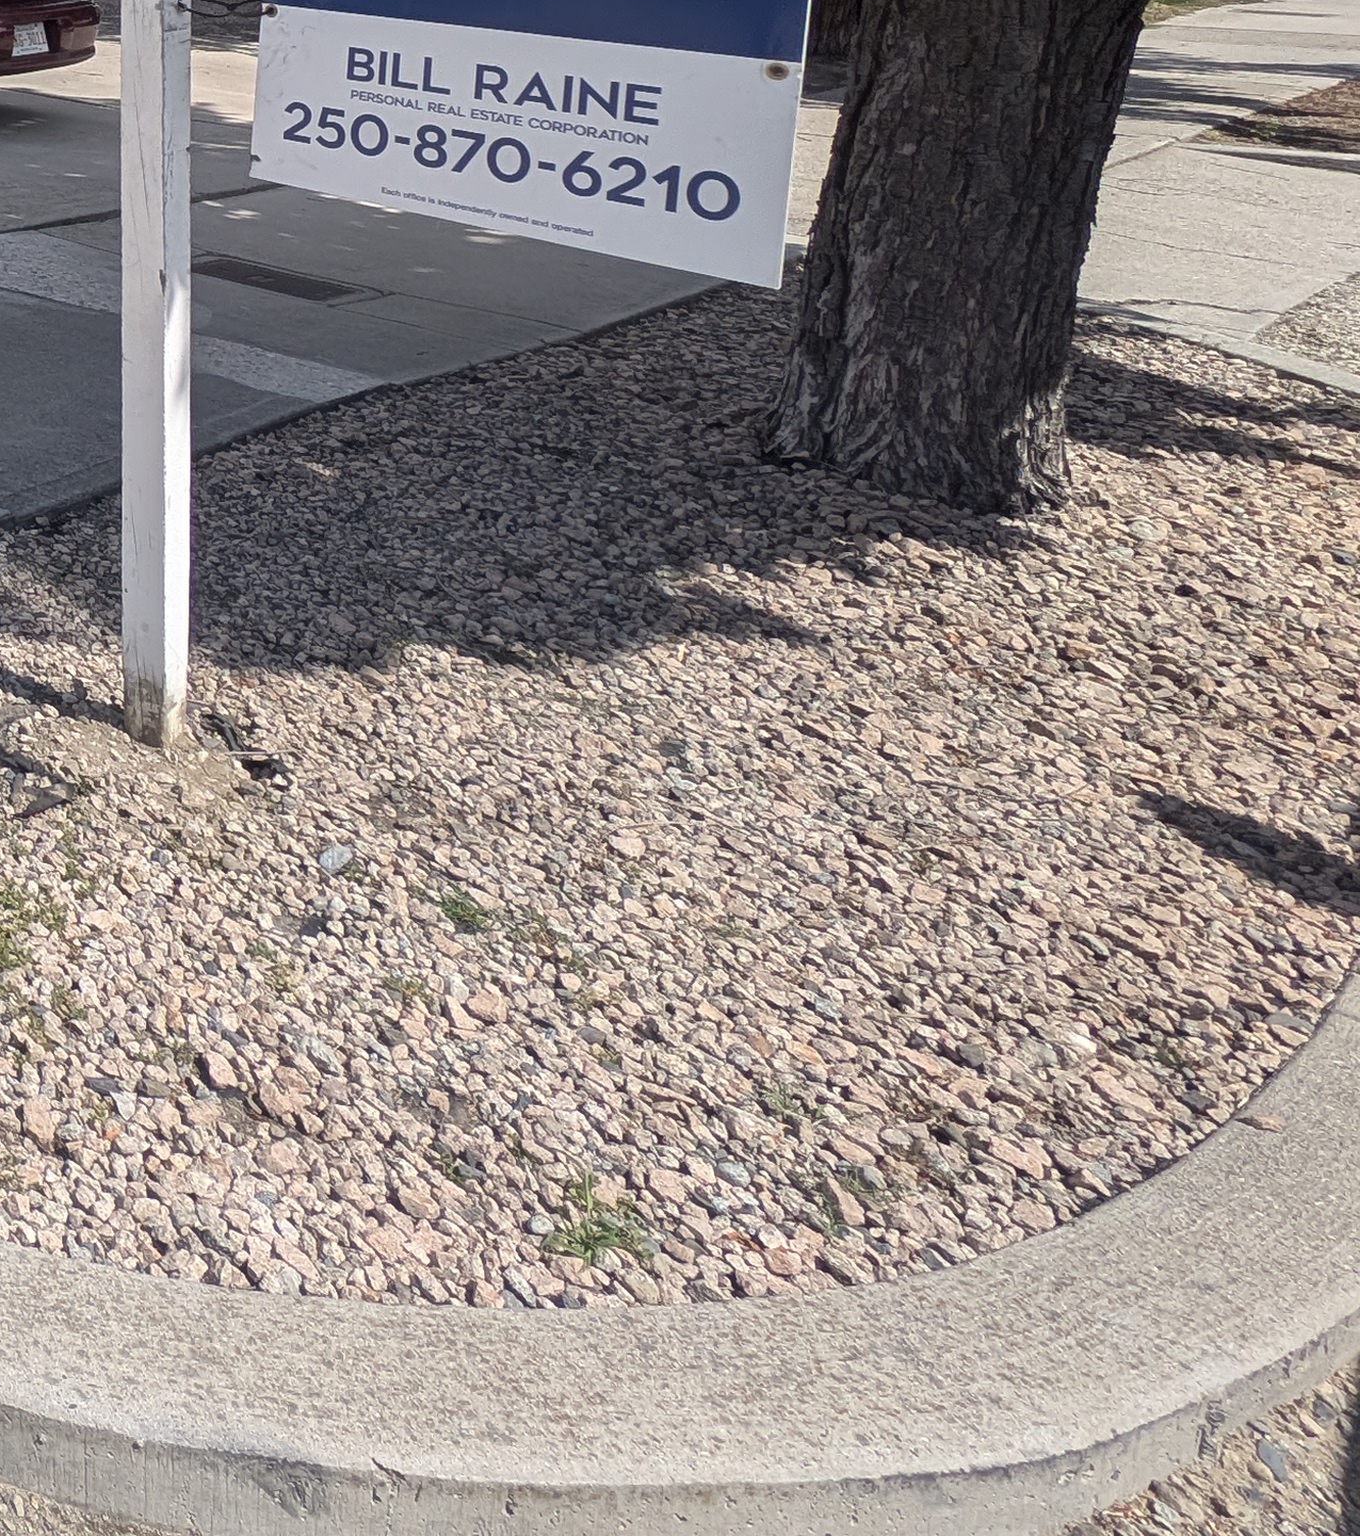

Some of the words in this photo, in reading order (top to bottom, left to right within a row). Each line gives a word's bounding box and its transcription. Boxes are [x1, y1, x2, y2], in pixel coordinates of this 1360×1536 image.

[346, 46, 451, 96] BILL
[474, 64, 662, 126] RAINE
[350, 89, 423, 112] PERSONAL
[427, 101, 467, 119] REAL
[470, 108, 524, 128] ESTATE
[528, 117, 650, 146] CORPORATION
[283, 101, 741, 221] 250-870-6210
[381, 186, 401, 197] Each
[403, 190, 426, 203] office
[428, 196, 435, 204] is
[499, 211, 529, 224] owned
[531, 218, 549, 228] and
